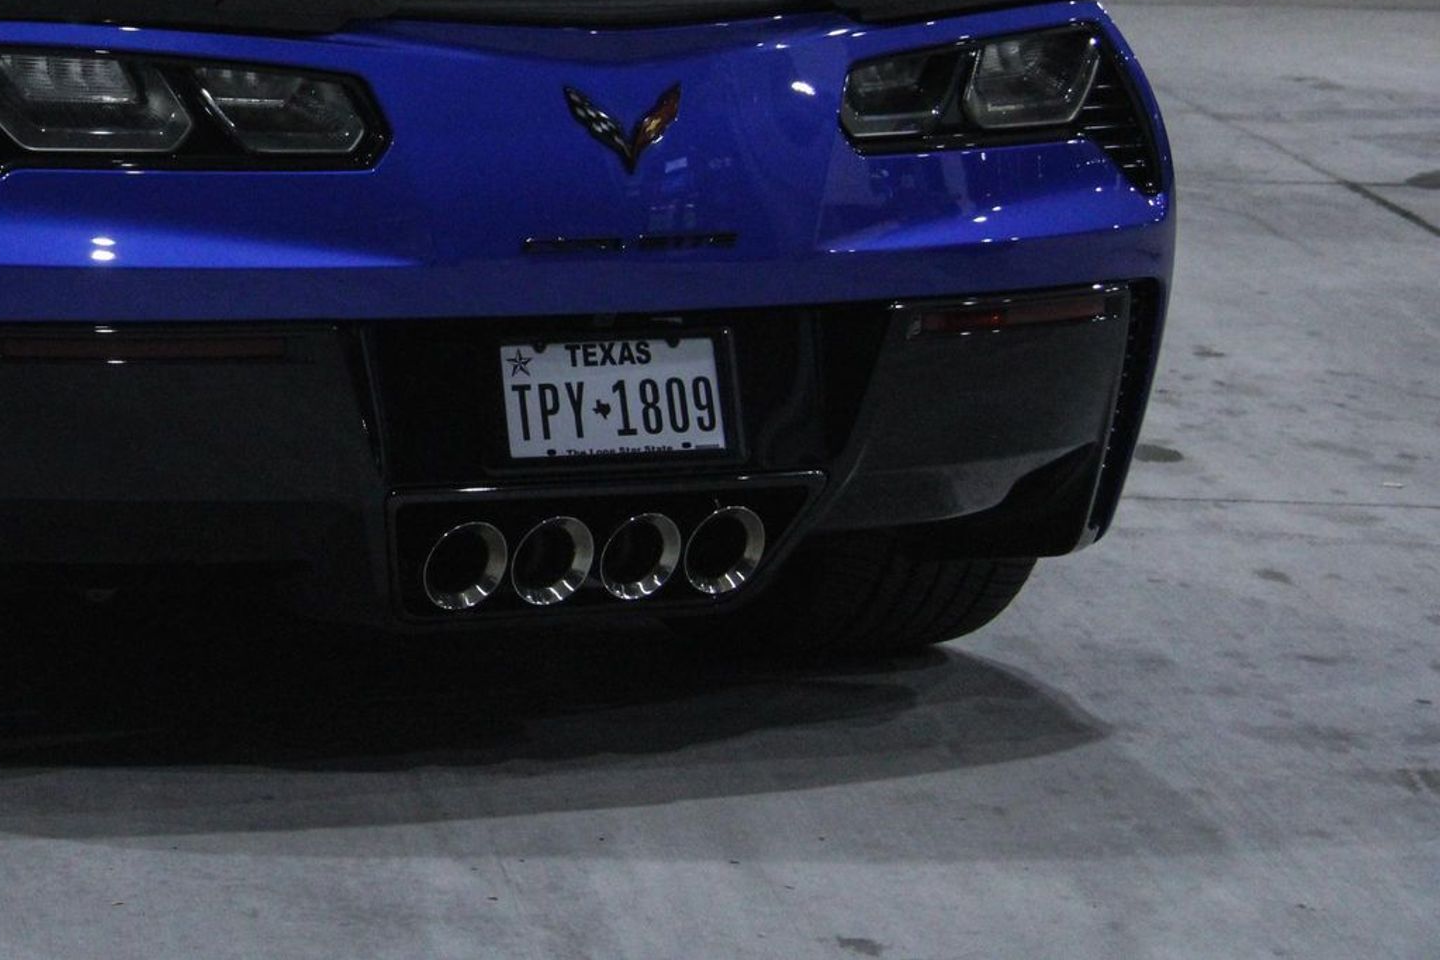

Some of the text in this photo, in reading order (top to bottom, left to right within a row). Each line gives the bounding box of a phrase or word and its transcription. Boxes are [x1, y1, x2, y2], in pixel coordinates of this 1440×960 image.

[565, 341, 652, 367] TEXAS
[511, 375, 716, 441] TPY 1809
